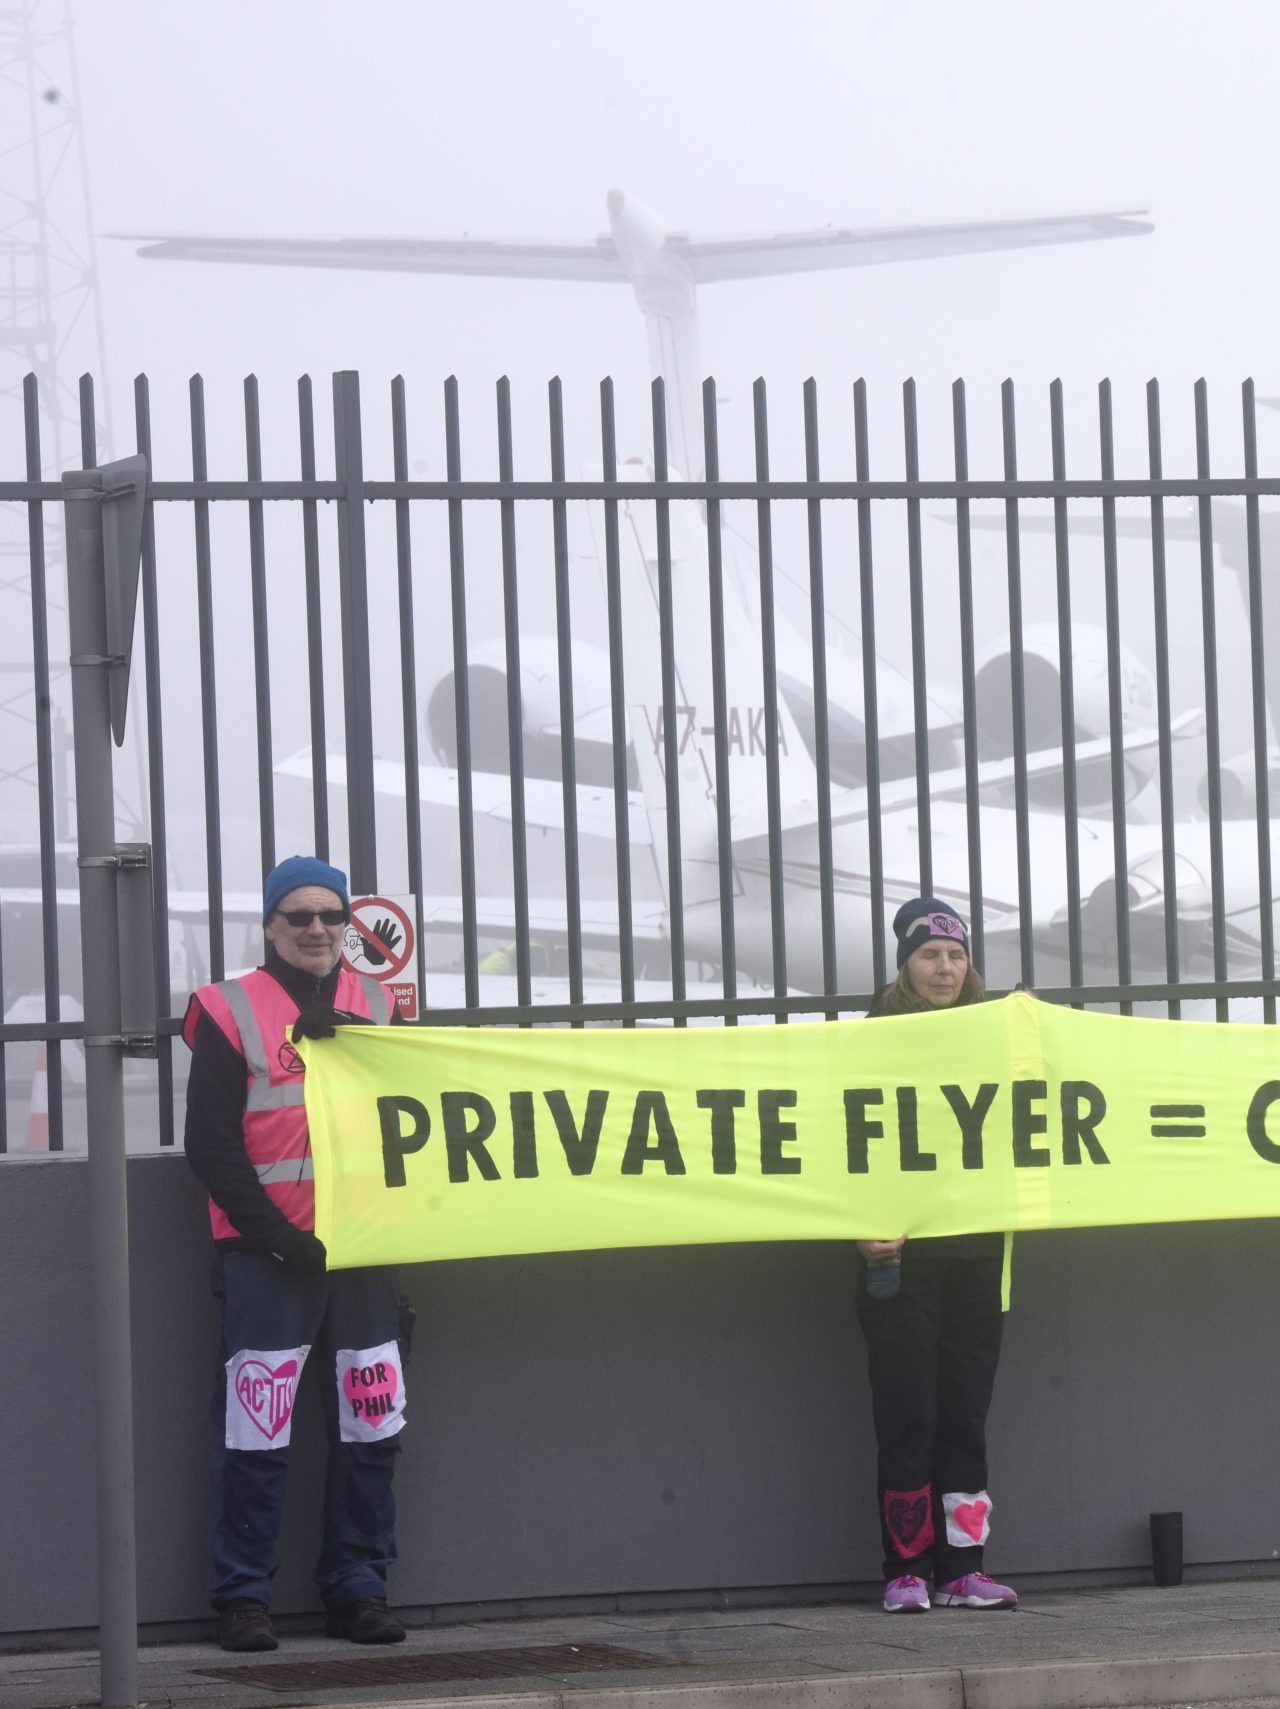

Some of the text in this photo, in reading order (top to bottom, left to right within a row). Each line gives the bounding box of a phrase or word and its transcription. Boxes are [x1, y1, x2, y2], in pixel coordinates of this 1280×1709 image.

[376, 1088, 803, 1188] PRIVATE
[842, 1079, 1112, 1174] FLYER
[1149, 1103, 1207, 1138] =
[350, 1362, 389, 1389] FOR
[351, 1392, 396, 1419] PHIL
